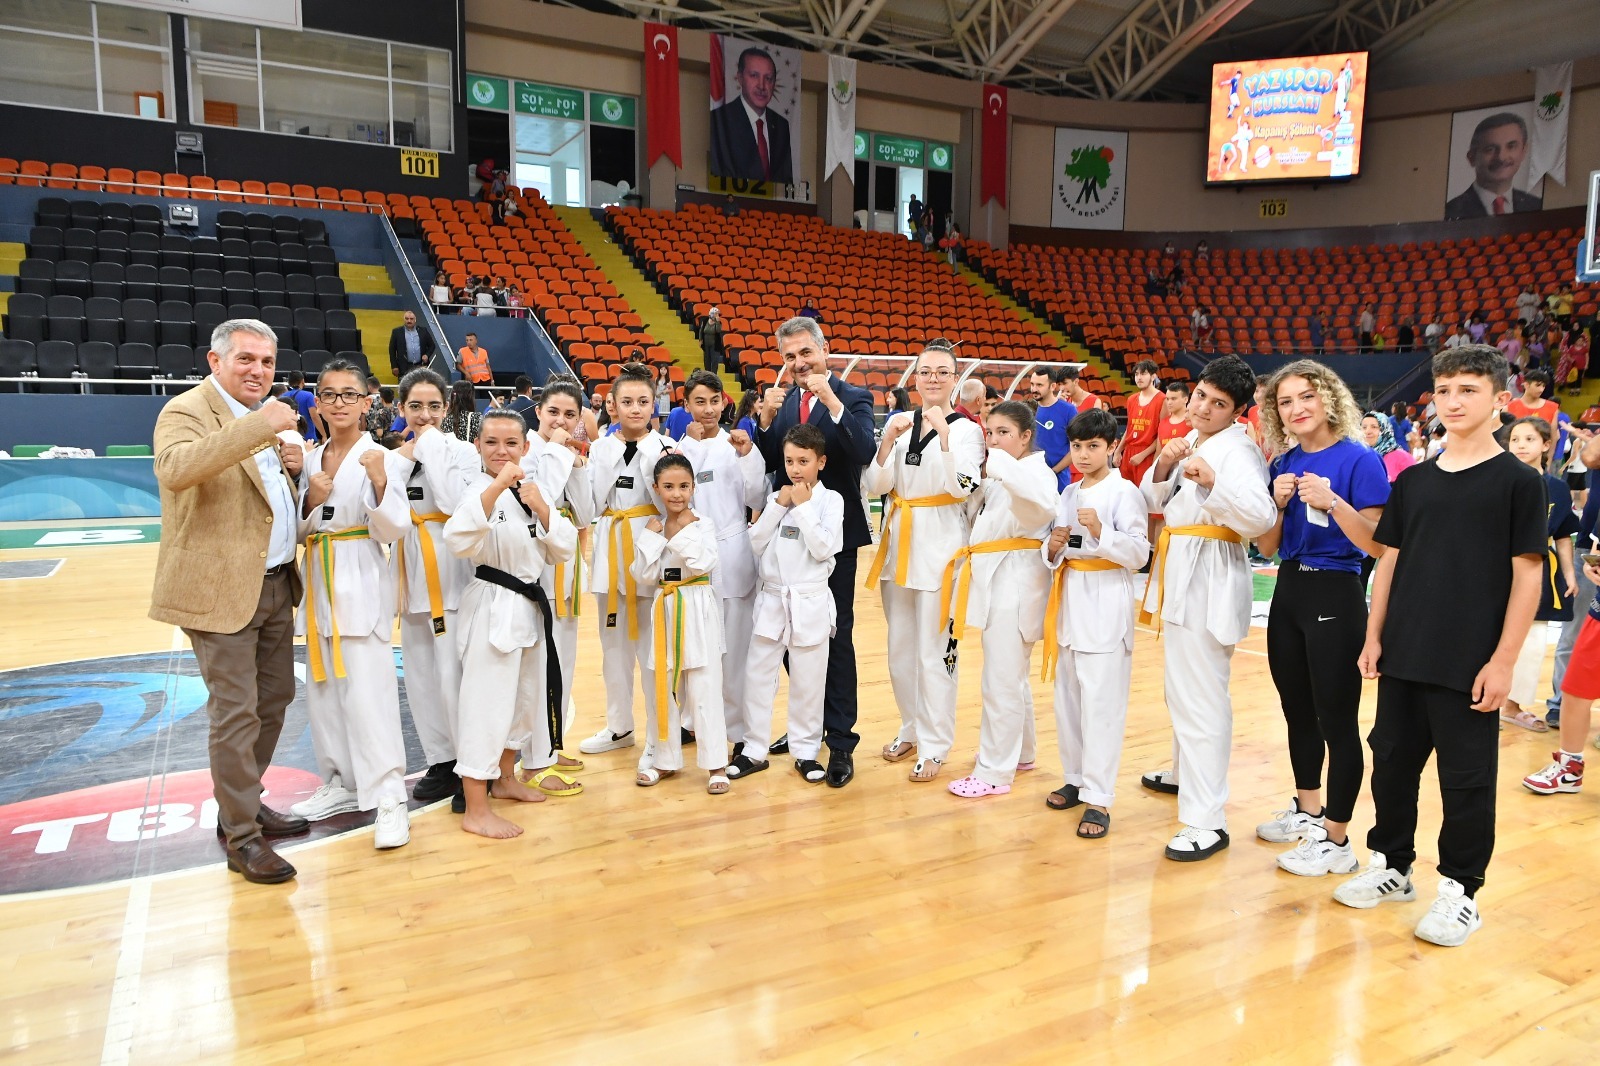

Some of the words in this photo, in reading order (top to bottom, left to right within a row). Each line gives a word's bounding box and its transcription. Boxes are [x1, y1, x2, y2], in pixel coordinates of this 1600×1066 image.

[1252, 95, 1321, 117] KURSLARI
[406, 156, 434, 176] 101
[1058, 184, 1076, 213] MAMAK
[1261, 203, 1286, 216] 103
